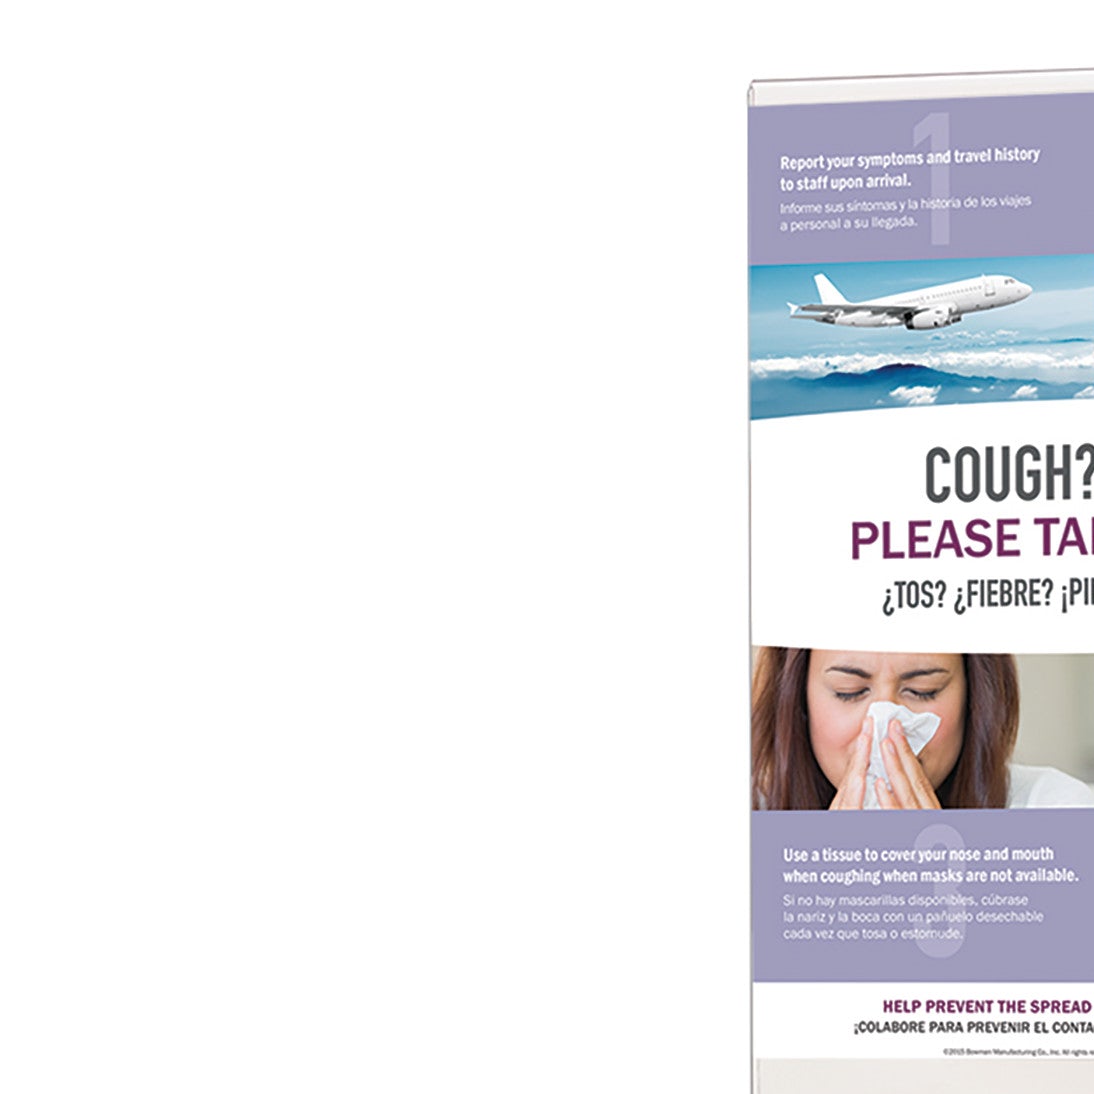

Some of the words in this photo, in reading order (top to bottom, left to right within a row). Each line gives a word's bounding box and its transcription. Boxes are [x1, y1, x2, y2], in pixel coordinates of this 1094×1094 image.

[780, 154, 825, 172] Report
[826, 155, 856, 171] your
[857, 151, 924, 170] symptoms
[925, 149, 951, 164] and
[953, 147, 992, 164] travel
[994, 146, 1041, 163] history
[779, 177, 794, 192] to
[796, 174, 828, 191] staff
[830, 176, 864, 192] upon
[865, 172, 912, 188] arrival.
[912, 112, 950, 245] 1
[851, 518, 1021, 559] PLEASE
[882, 580, 946, 616] ¿TOS?
[953, 577, 1054, 615] ¿FIEBRE?
[783, 847, 809, 862] Use
[810, 849, 820, 862] a
[821, 847, 862, 862] tissue
[863, 847, 879, 862] to
[880, 849, 917, 862] cover
[917, 849, 947, 864] your
[948, 848, 981, 862] nose
[982, 846, 1009, 861] and
[1011, 846, 1054, 861] mouth
[782, 868, 818, 883] when
[819, 868, 881, 886] coughing
[882, 868, 918, 883] when
[919, 868, 964, 883] masks
[965, 870, 988, 883] are
[989, 867, 1013, 883] not
[1014, 867, 1079, 882] available.
[913, 823, 966, 958] 3
[882, 999, 922, 1014] HELP
[925, 999, 994, 1014] PREVENT
[996, 999, 1027, 1014] THE
[1029, 999, 1092, 1014] SPREAD
[853, 1020, 926, 1035] ¡COLABORE
[928, 1020, 964, 1033] PARA
[966, 1020, 1031, 1034] PREVENIR
[1033, 1020, 1050, 1034] EL
